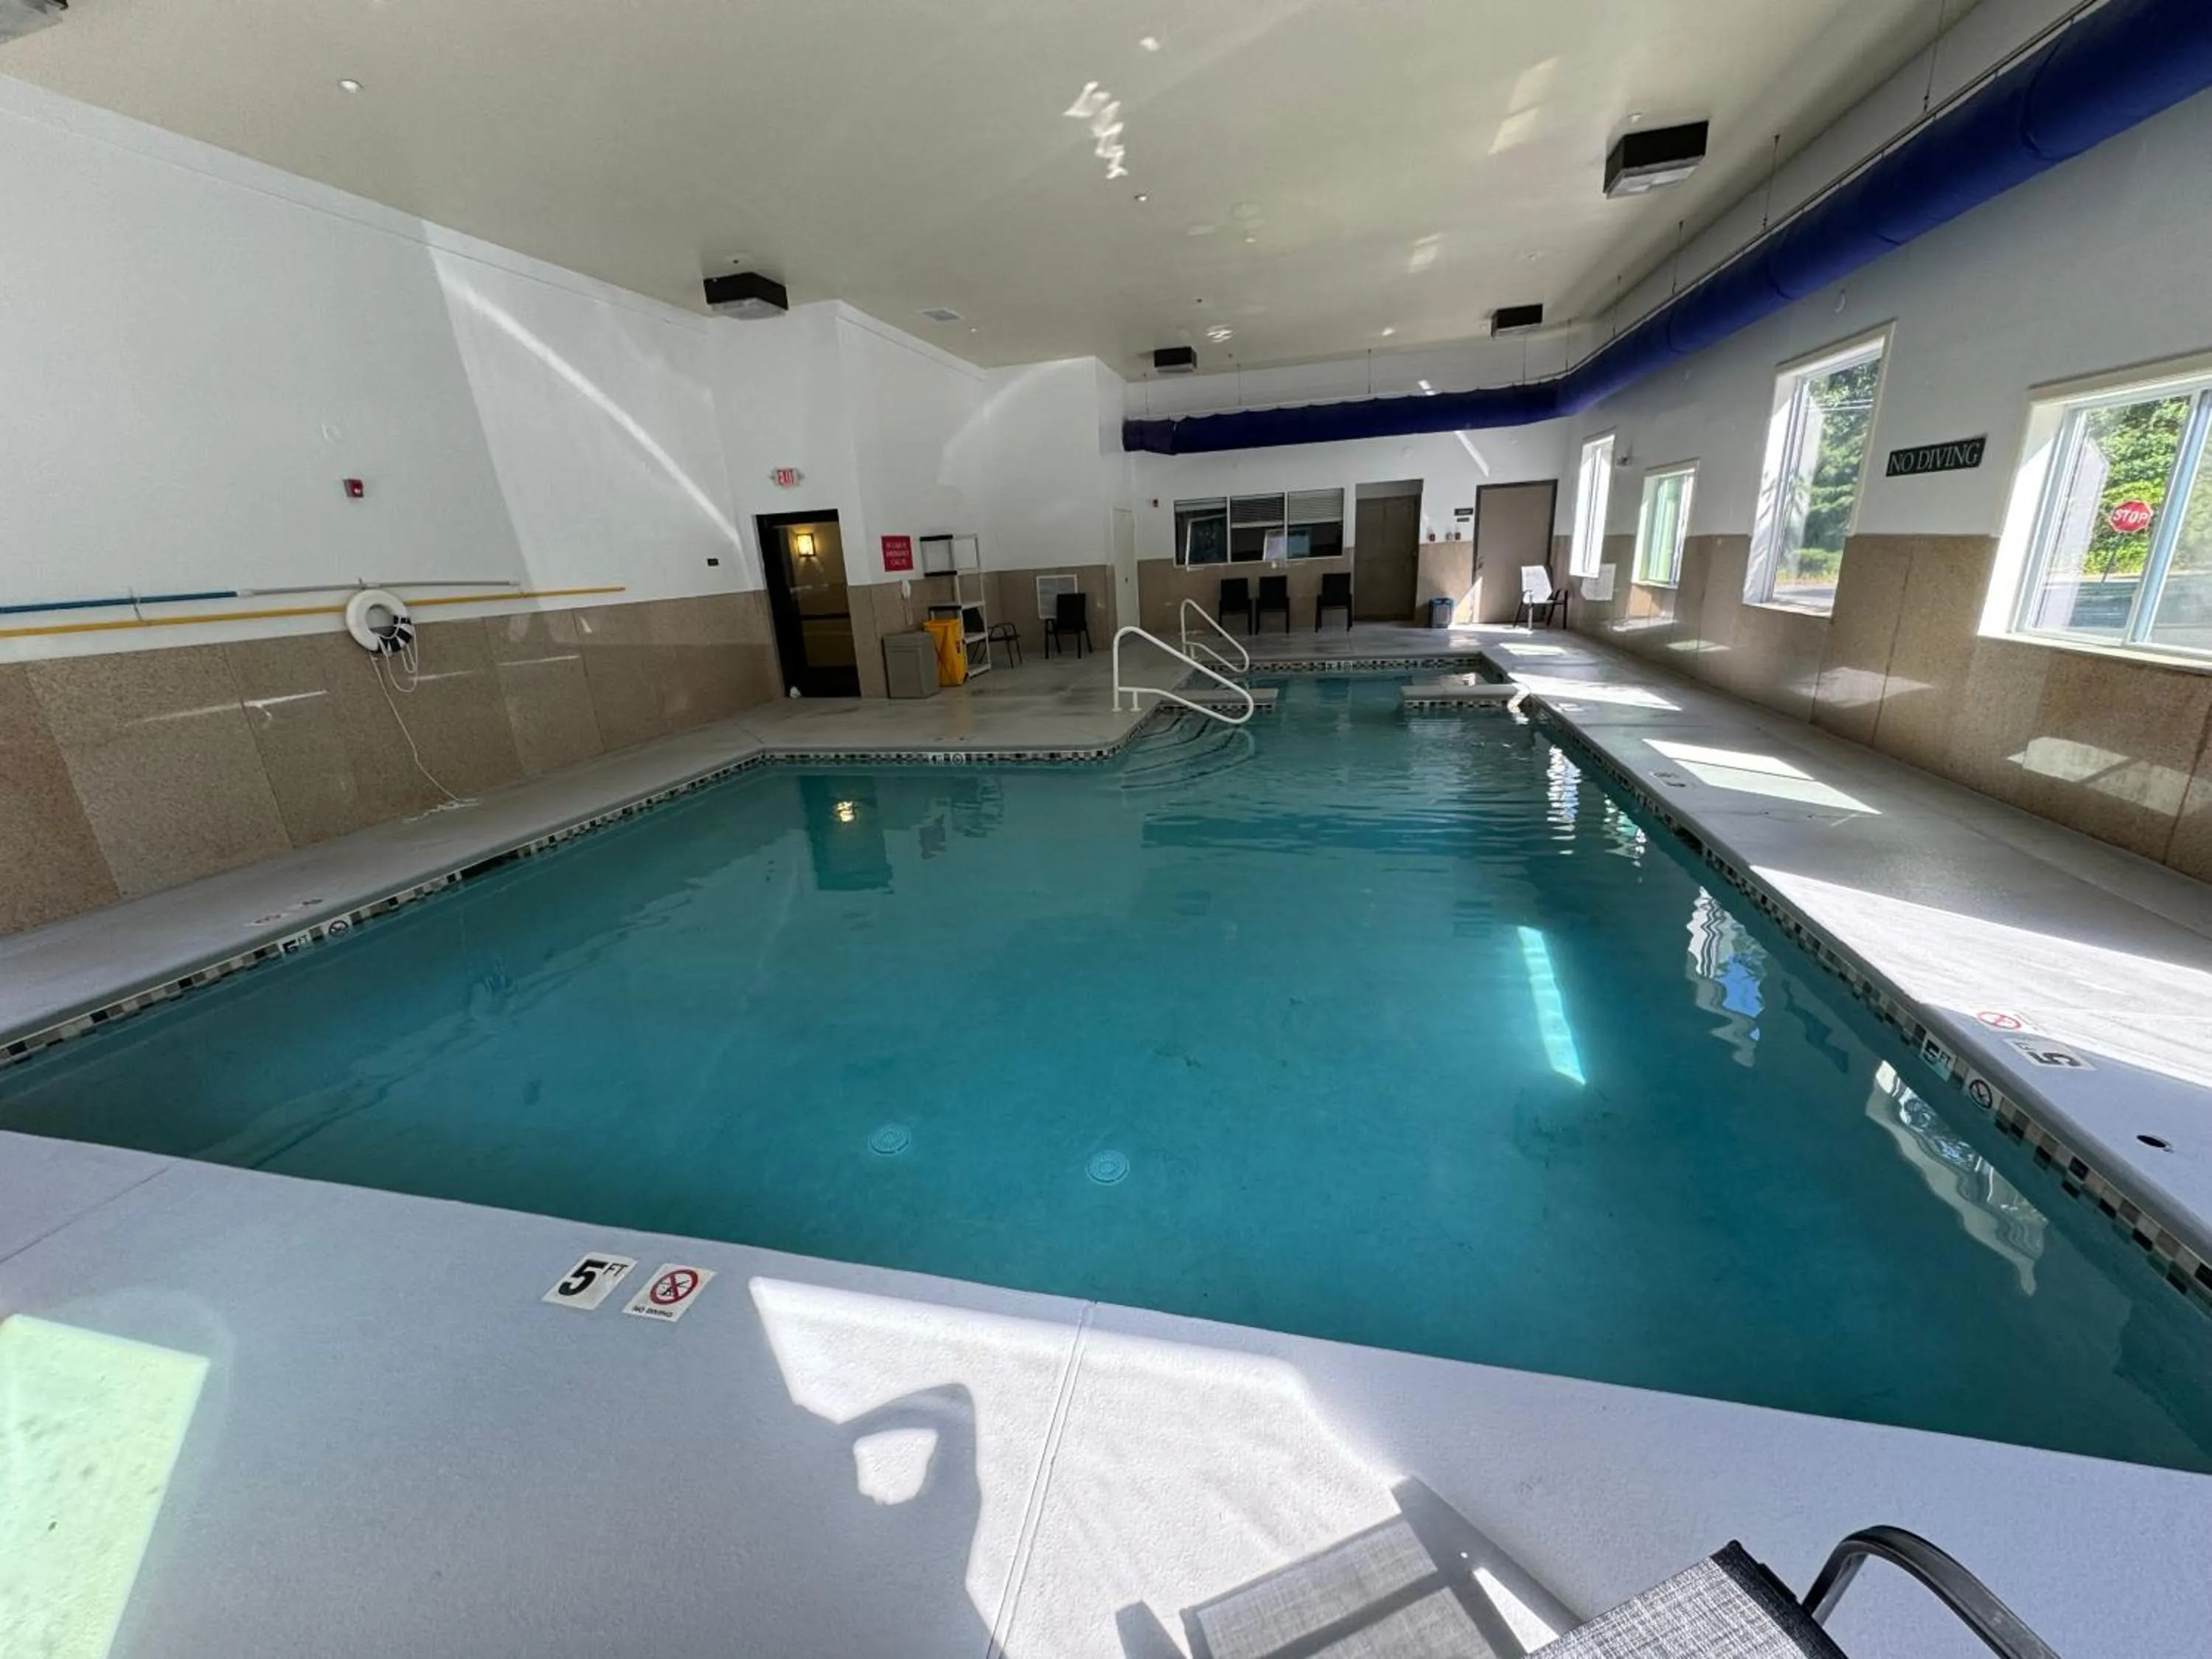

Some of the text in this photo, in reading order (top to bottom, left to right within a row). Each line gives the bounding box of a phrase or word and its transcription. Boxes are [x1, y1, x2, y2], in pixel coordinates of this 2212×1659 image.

[1889, 442, 1981, 473] NO DIVING
[2112, 508, 2149, 524] STOP
[2028, 1051, 2082, 1067] 5
[558, 1259, 629, 1296] 5 FT
[632, 1305, 673, 1318] NO DIVING
